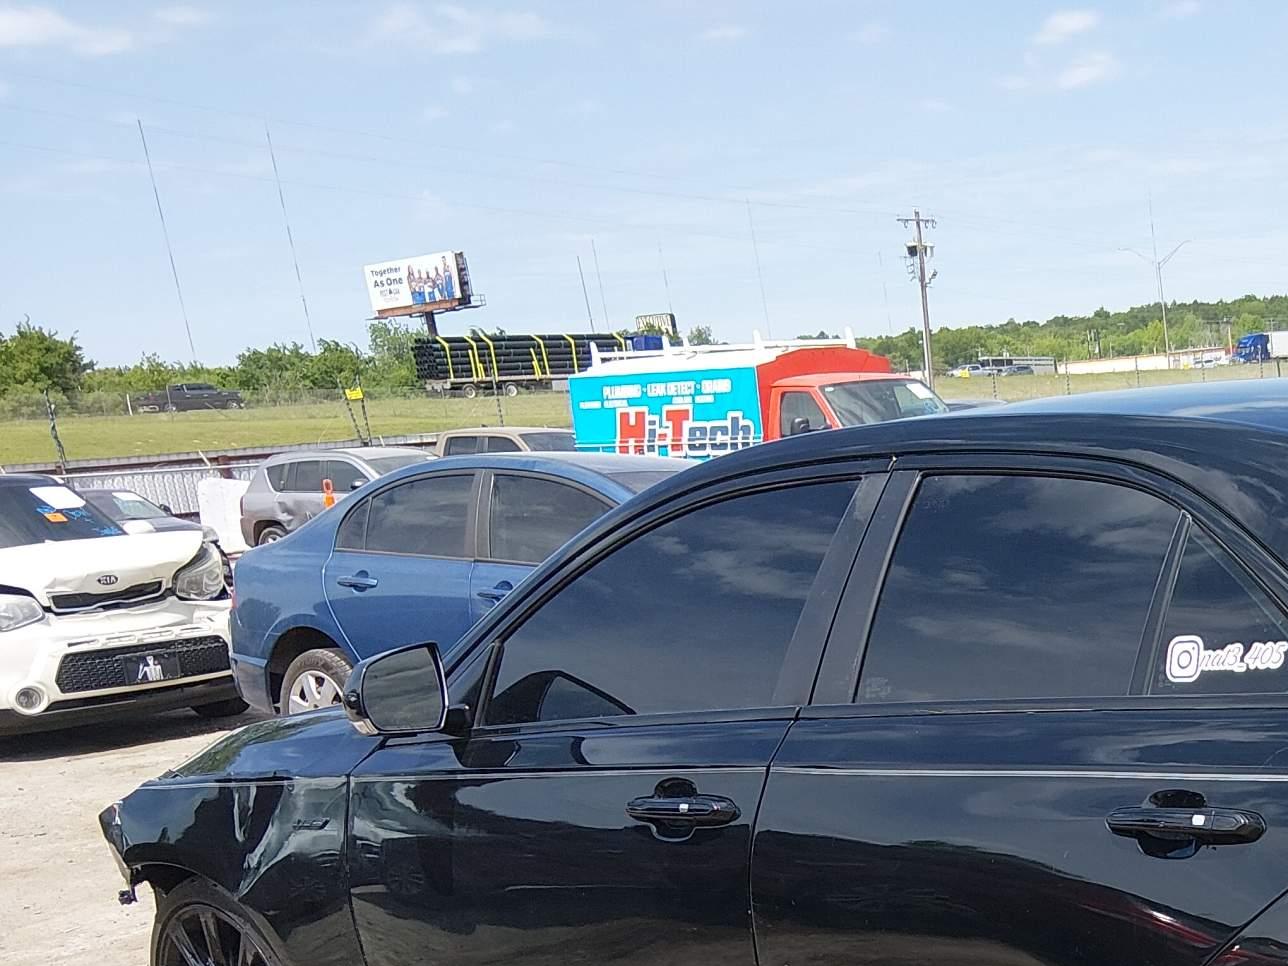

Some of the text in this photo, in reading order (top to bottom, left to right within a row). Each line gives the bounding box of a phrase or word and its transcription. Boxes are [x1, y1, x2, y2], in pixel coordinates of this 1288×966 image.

[370, 266, 401, 278] Together
[373, 277, 404, 288] As One
[618, 408, 751, 454] Hi-Tech
[99, 575, 117, 585] KIA
